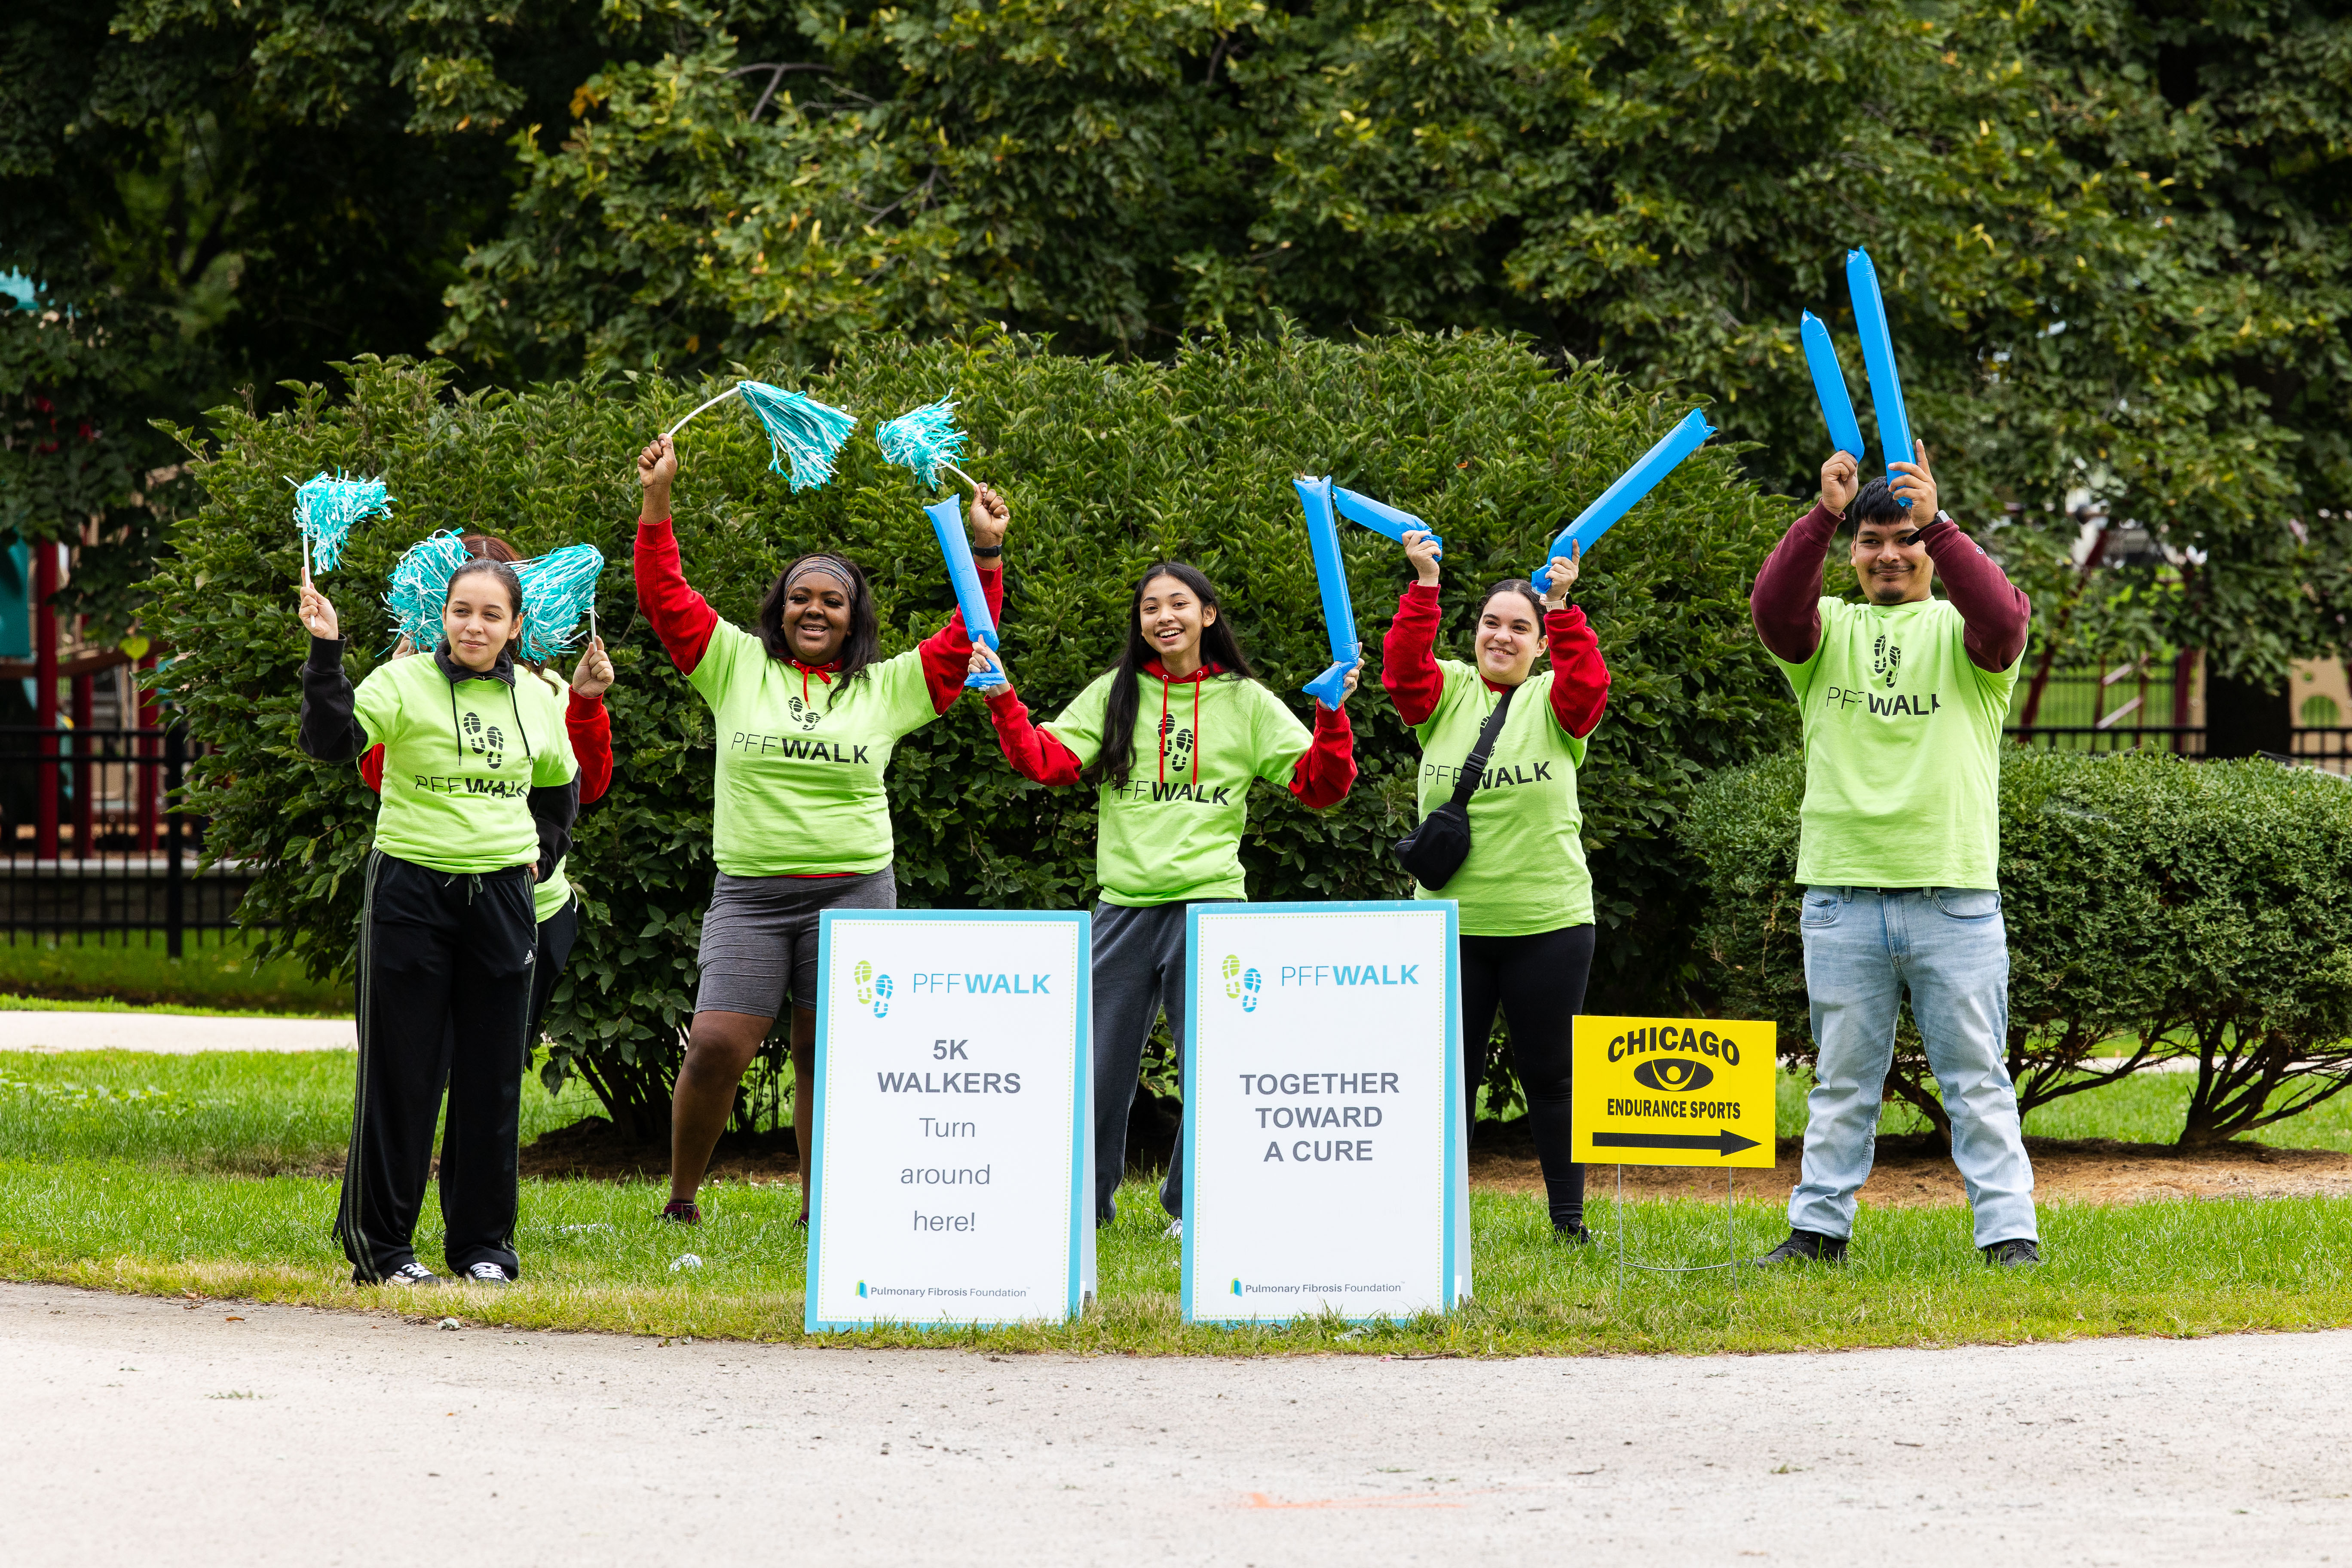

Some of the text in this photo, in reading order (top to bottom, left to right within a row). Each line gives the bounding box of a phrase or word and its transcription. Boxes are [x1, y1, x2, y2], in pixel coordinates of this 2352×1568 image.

[933, 1039, 968, 1060] 5K
[1608, 1026, 1740, 1066] CHICAGO
[877, 1072, 1021, 1093] WALKERS
[1239, 1072, 1400, 1095] TOGETHER
[1255, 1106, 1382, 1128] TOWARD
[1607, 1098, 1740, 1119] ENDURANCE SPORTS
[919, 1118, 975, 1137] Turn
[1263, 1140, 1373, 1162] A CURE
[900, 1164, 990, 1185] around
[914, 1210, 975, 1231] here!
[871, 1287, 1026, 1298] Pulmonary Fibrosis Foundation
[1246, 1283, 1401, 1294] Pulmonary Fibrosis Foundation
